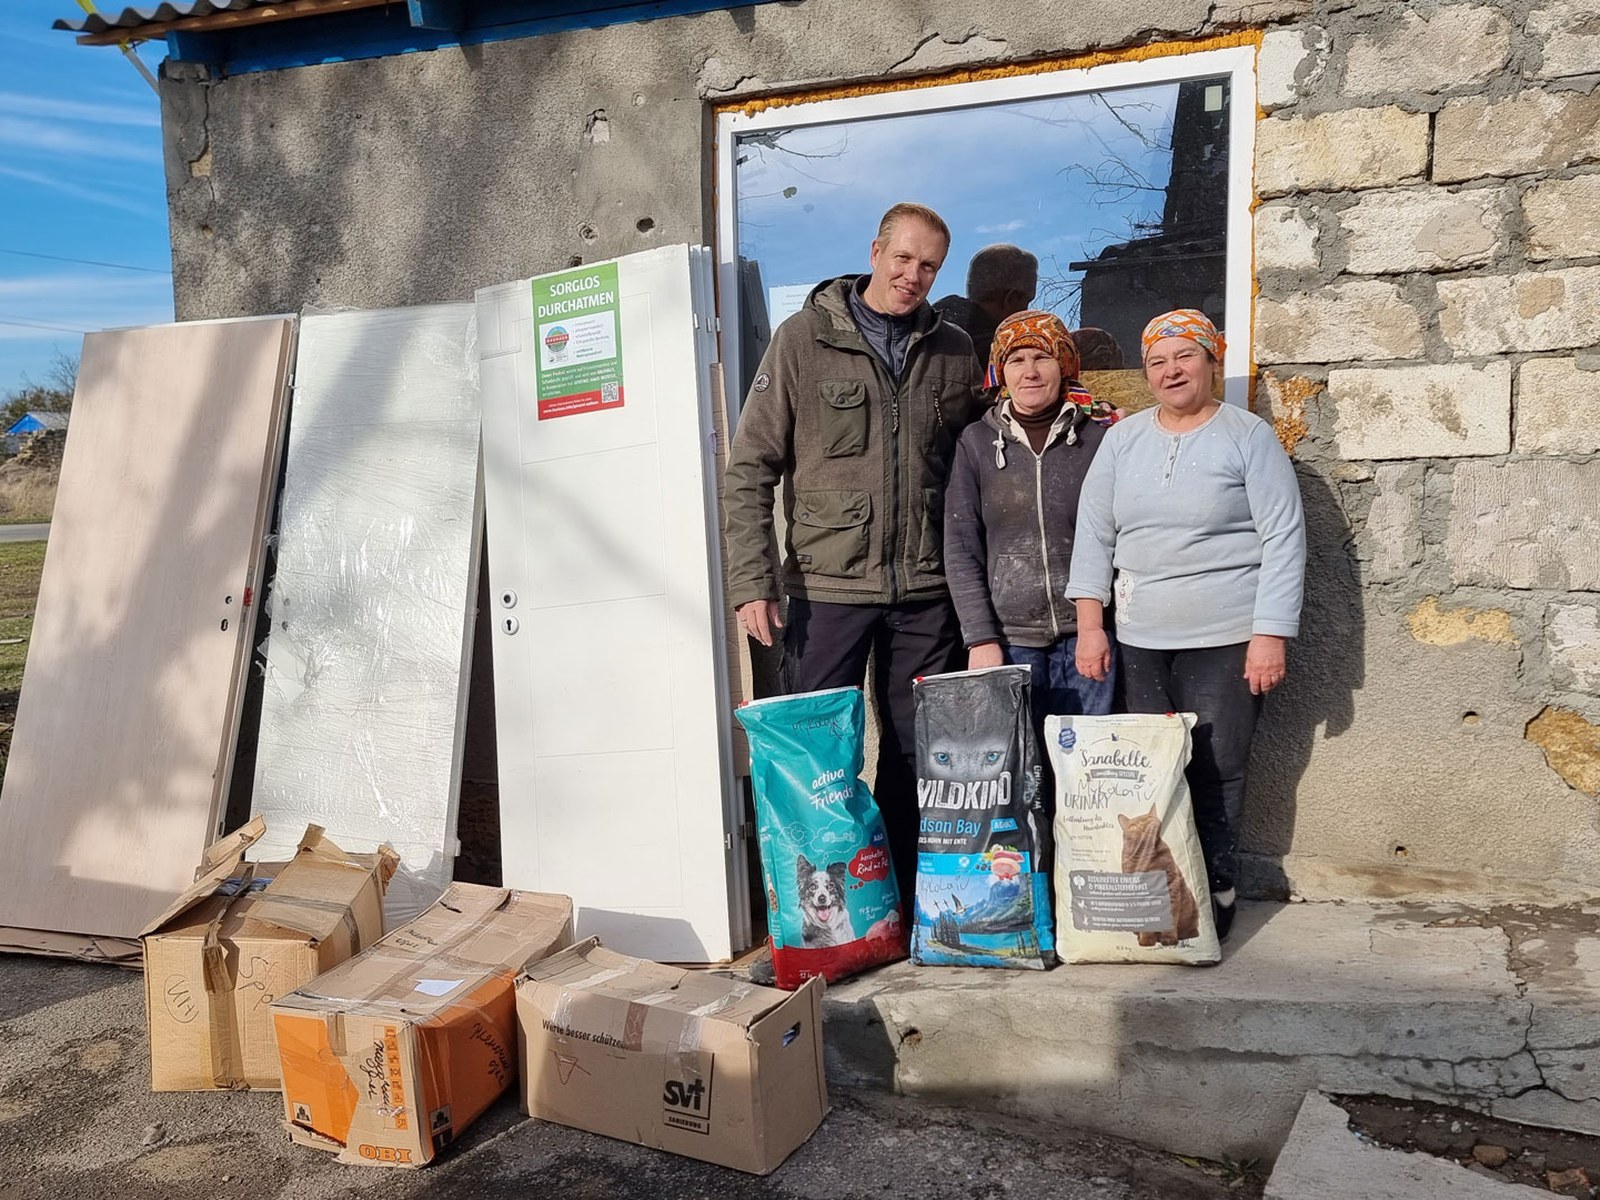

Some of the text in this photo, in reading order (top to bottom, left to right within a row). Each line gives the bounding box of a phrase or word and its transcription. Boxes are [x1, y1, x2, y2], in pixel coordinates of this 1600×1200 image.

[550, 275, 600, 297] SORGLOS
[538, 291, 614, 318] DURCHATMEN
[1081, 749, 1150, 768] Sanabelle
[812, 768, 845, 789] activa
[809, 786, 854, 811] Friends
[1064, 792, 1109, 810] URINARY
[919, 818, 981, 837] dson Bay
[542, 1019, 564, 1035] Werte
[565, 1025, 591, 1041] besser
[669, 1116, 701, 1128] SANIERUNG
[358, 1143, 412, 1164] OBI
